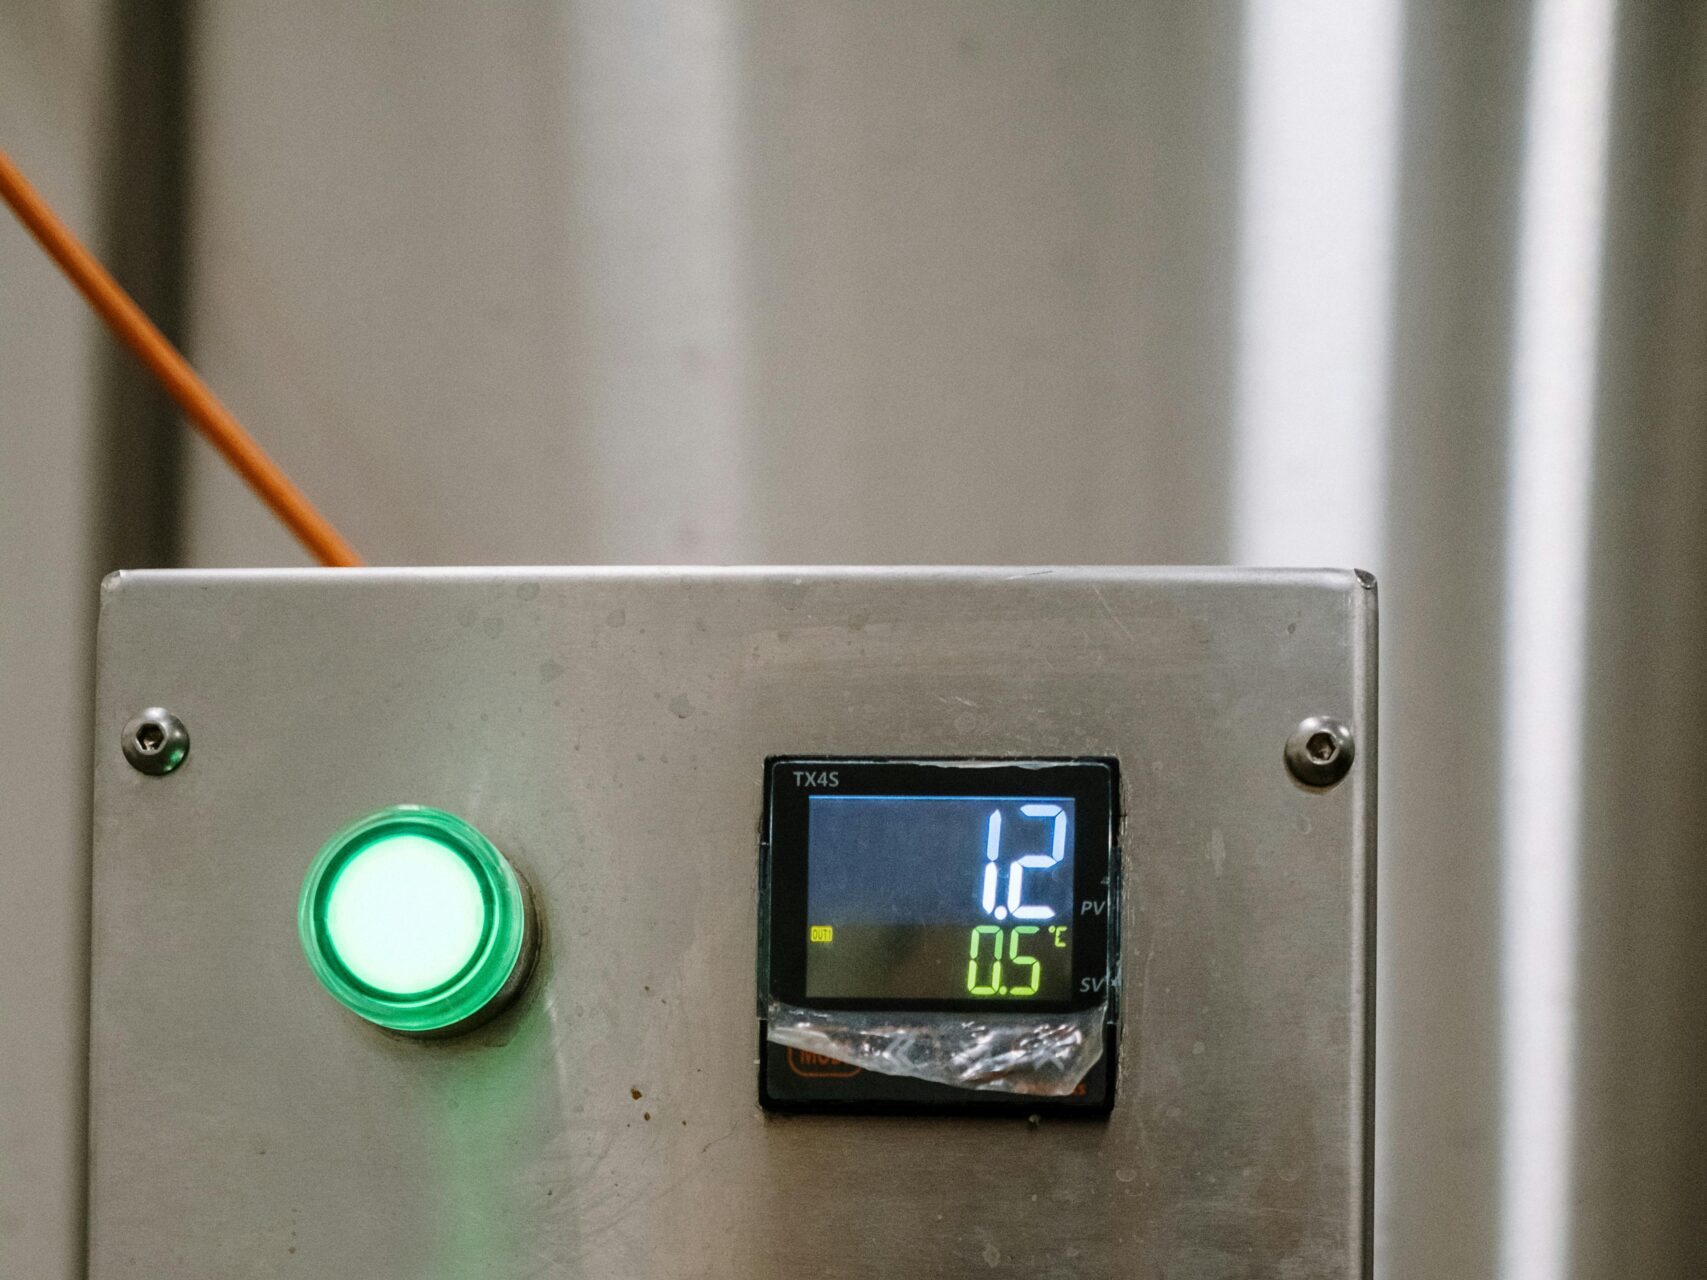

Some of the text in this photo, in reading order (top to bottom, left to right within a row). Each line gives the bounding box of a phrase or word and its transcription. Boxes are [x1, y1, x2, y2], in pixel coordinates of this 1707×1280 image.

[793, 771, 839, 788] TX4S
[982, 803, 1068, 921] 1.2
[1081, 900, 1106, 916] PV
[967, 925, 1041, 996] 0.5
[1080, 977, 1105, 993] SV
